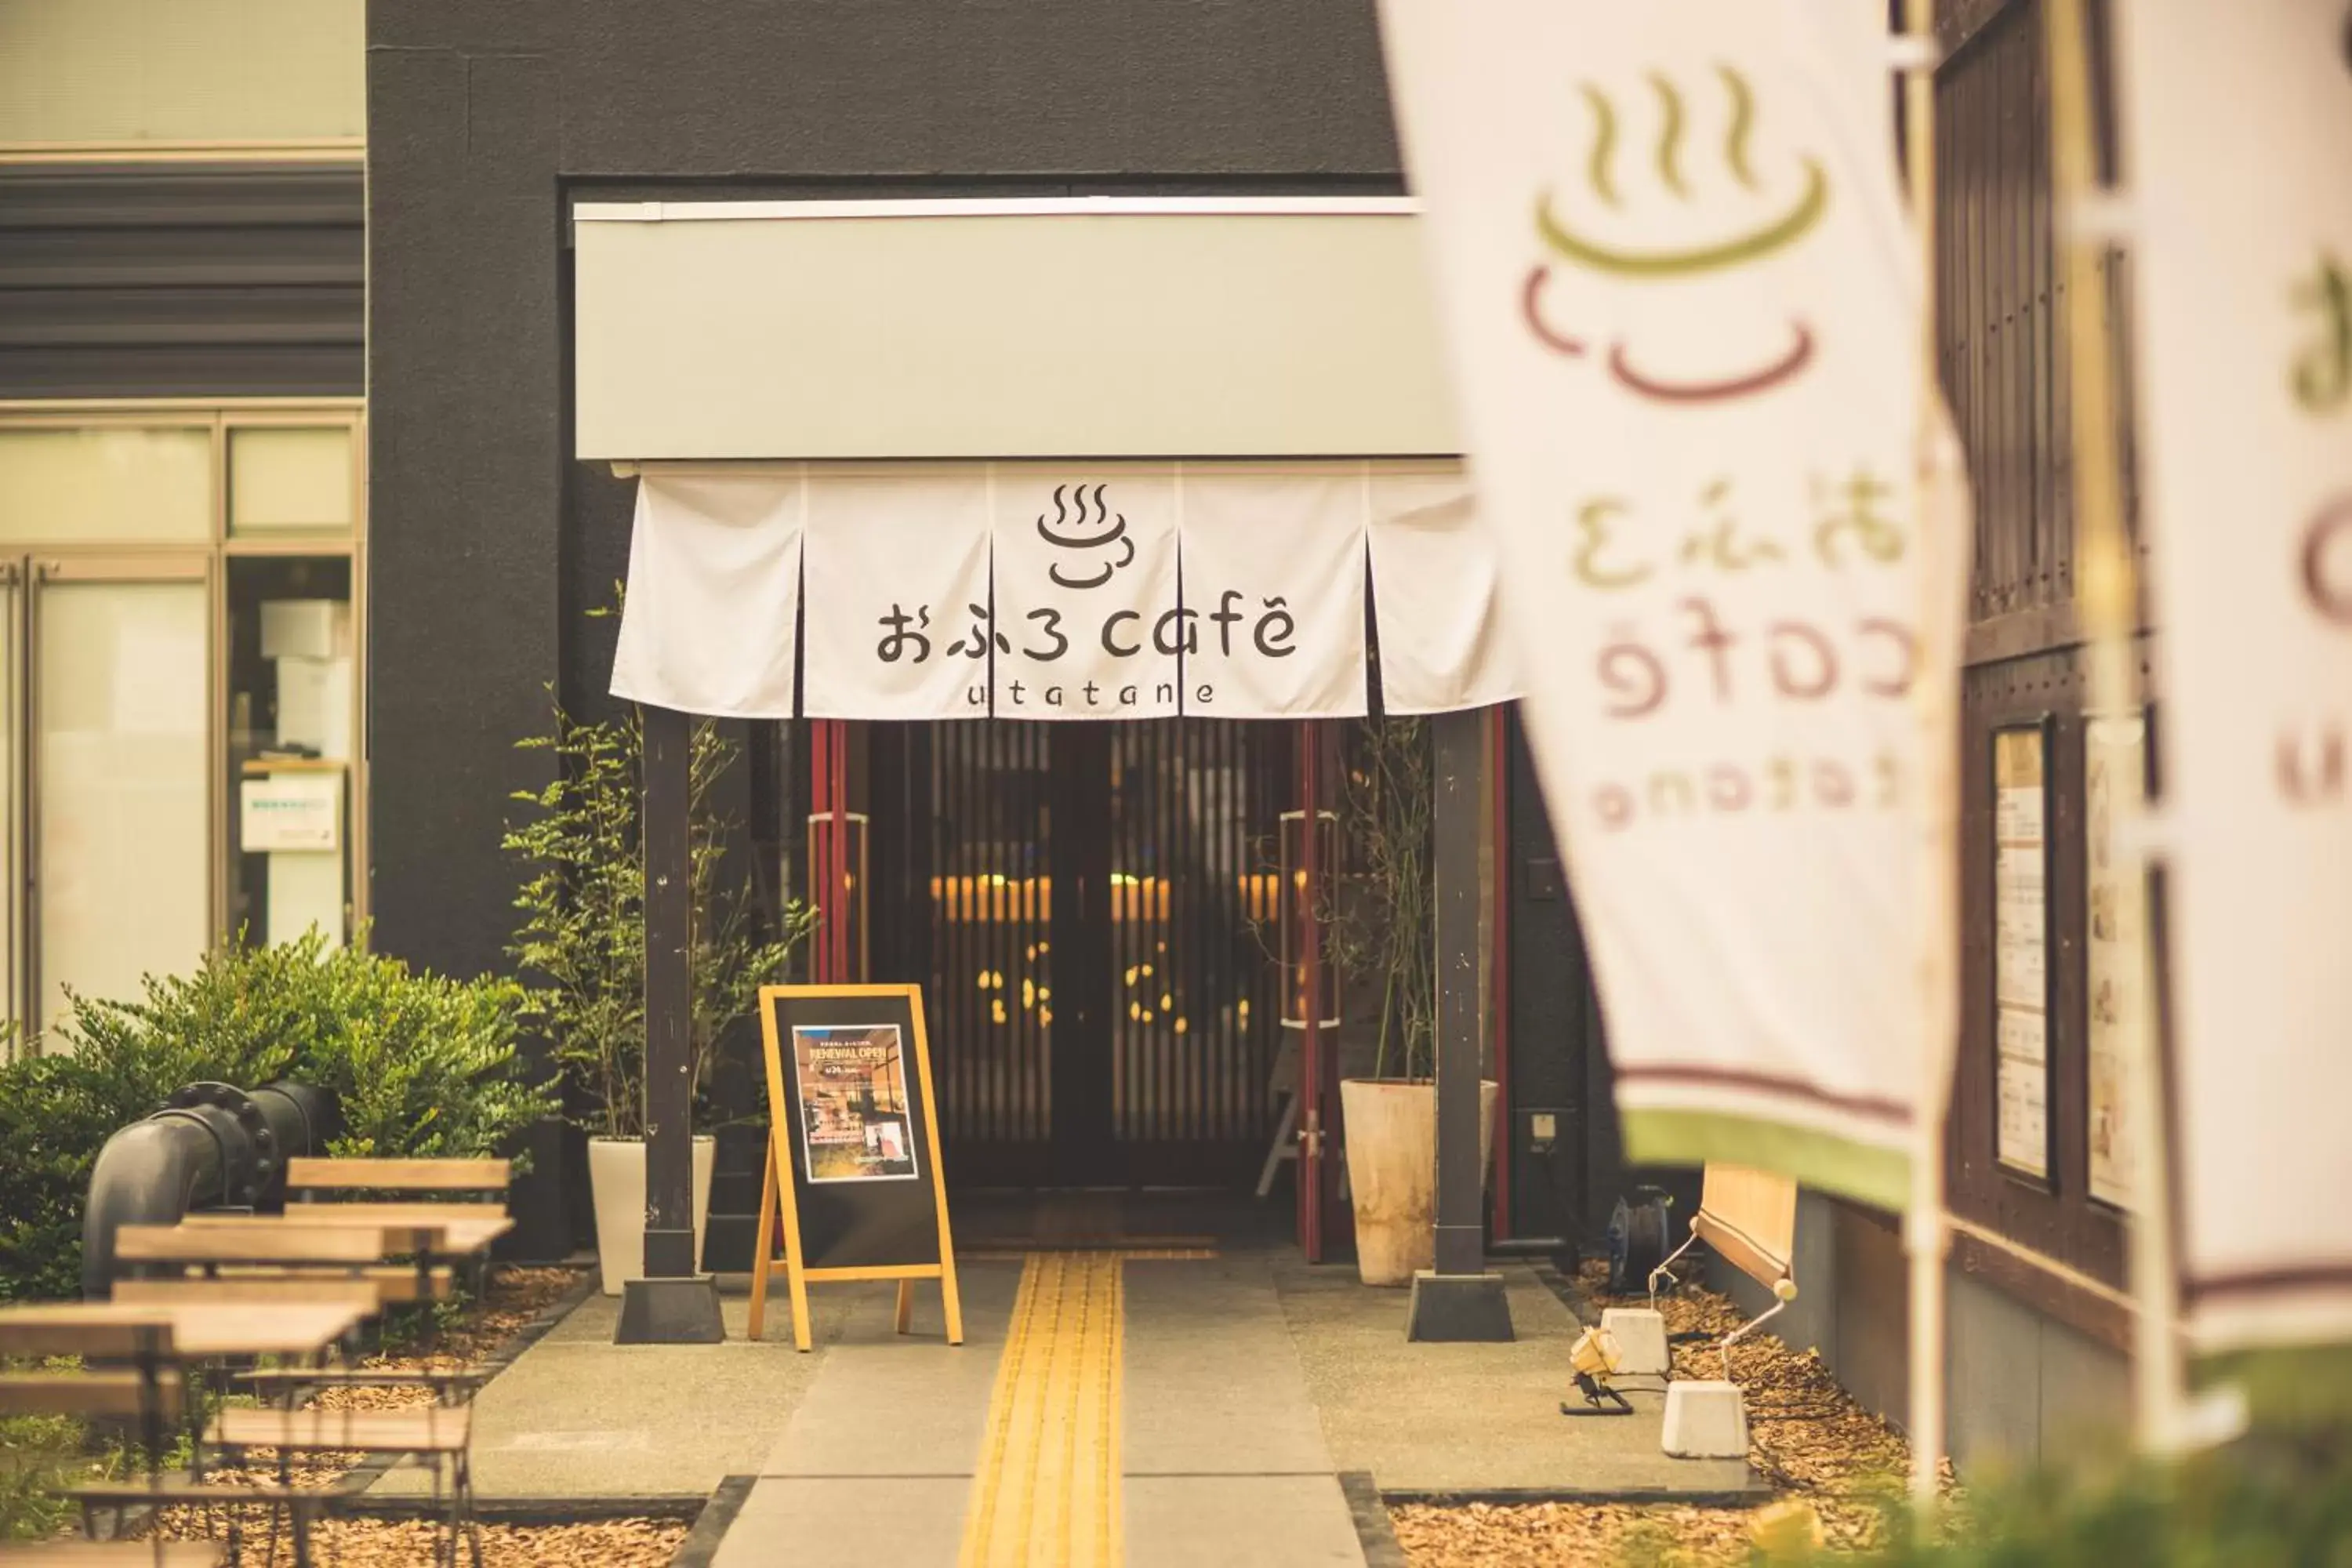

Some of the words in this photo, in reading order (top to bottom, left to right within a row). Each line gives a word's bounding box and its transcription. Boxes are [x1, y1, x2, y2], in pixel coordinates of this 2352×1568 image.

[876, 603, 1069, 662] おふろ
[967, 679, 1214, 706] utatane
